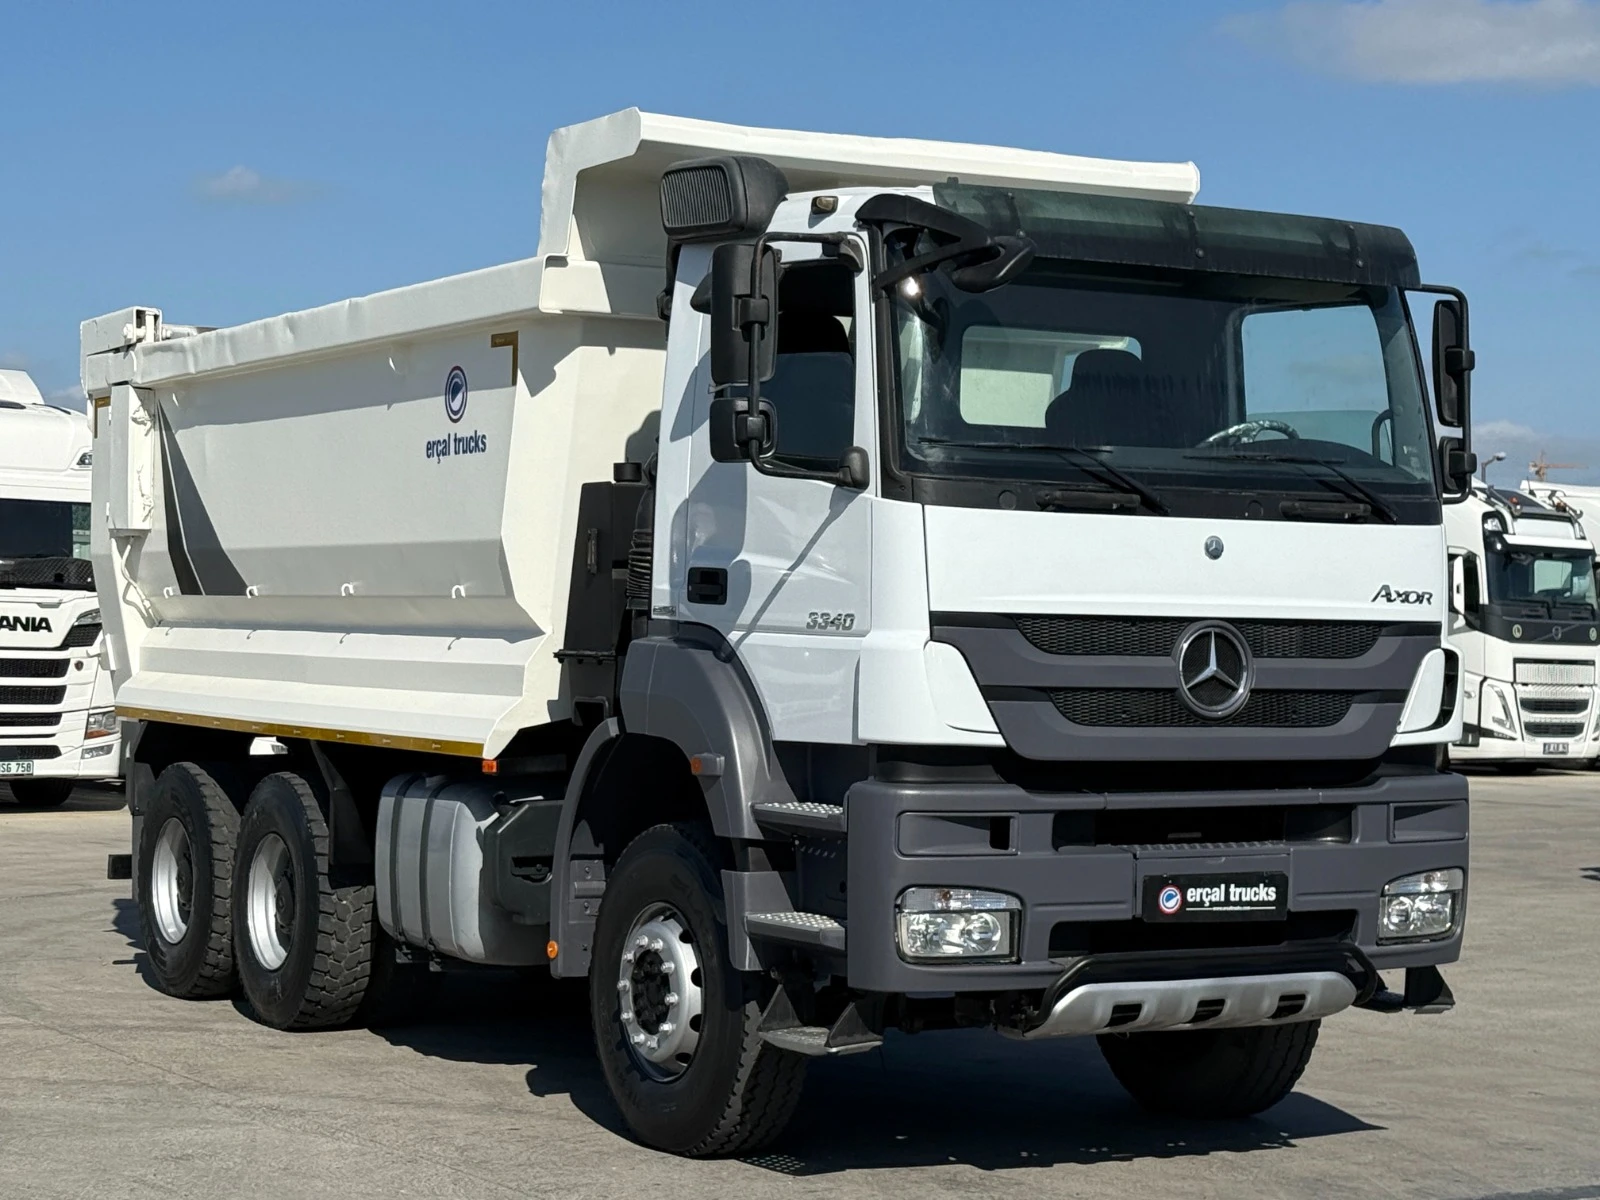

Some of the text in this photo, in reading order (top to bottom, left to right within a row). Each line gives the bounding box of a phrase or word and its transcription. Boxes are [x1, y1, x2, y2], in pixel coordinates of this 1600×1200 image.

[426, 430, 487, 464] erçal trucks
[806, 611, 855, 631] 3340
[1186, 883, 1277, 907] erçal trucks
